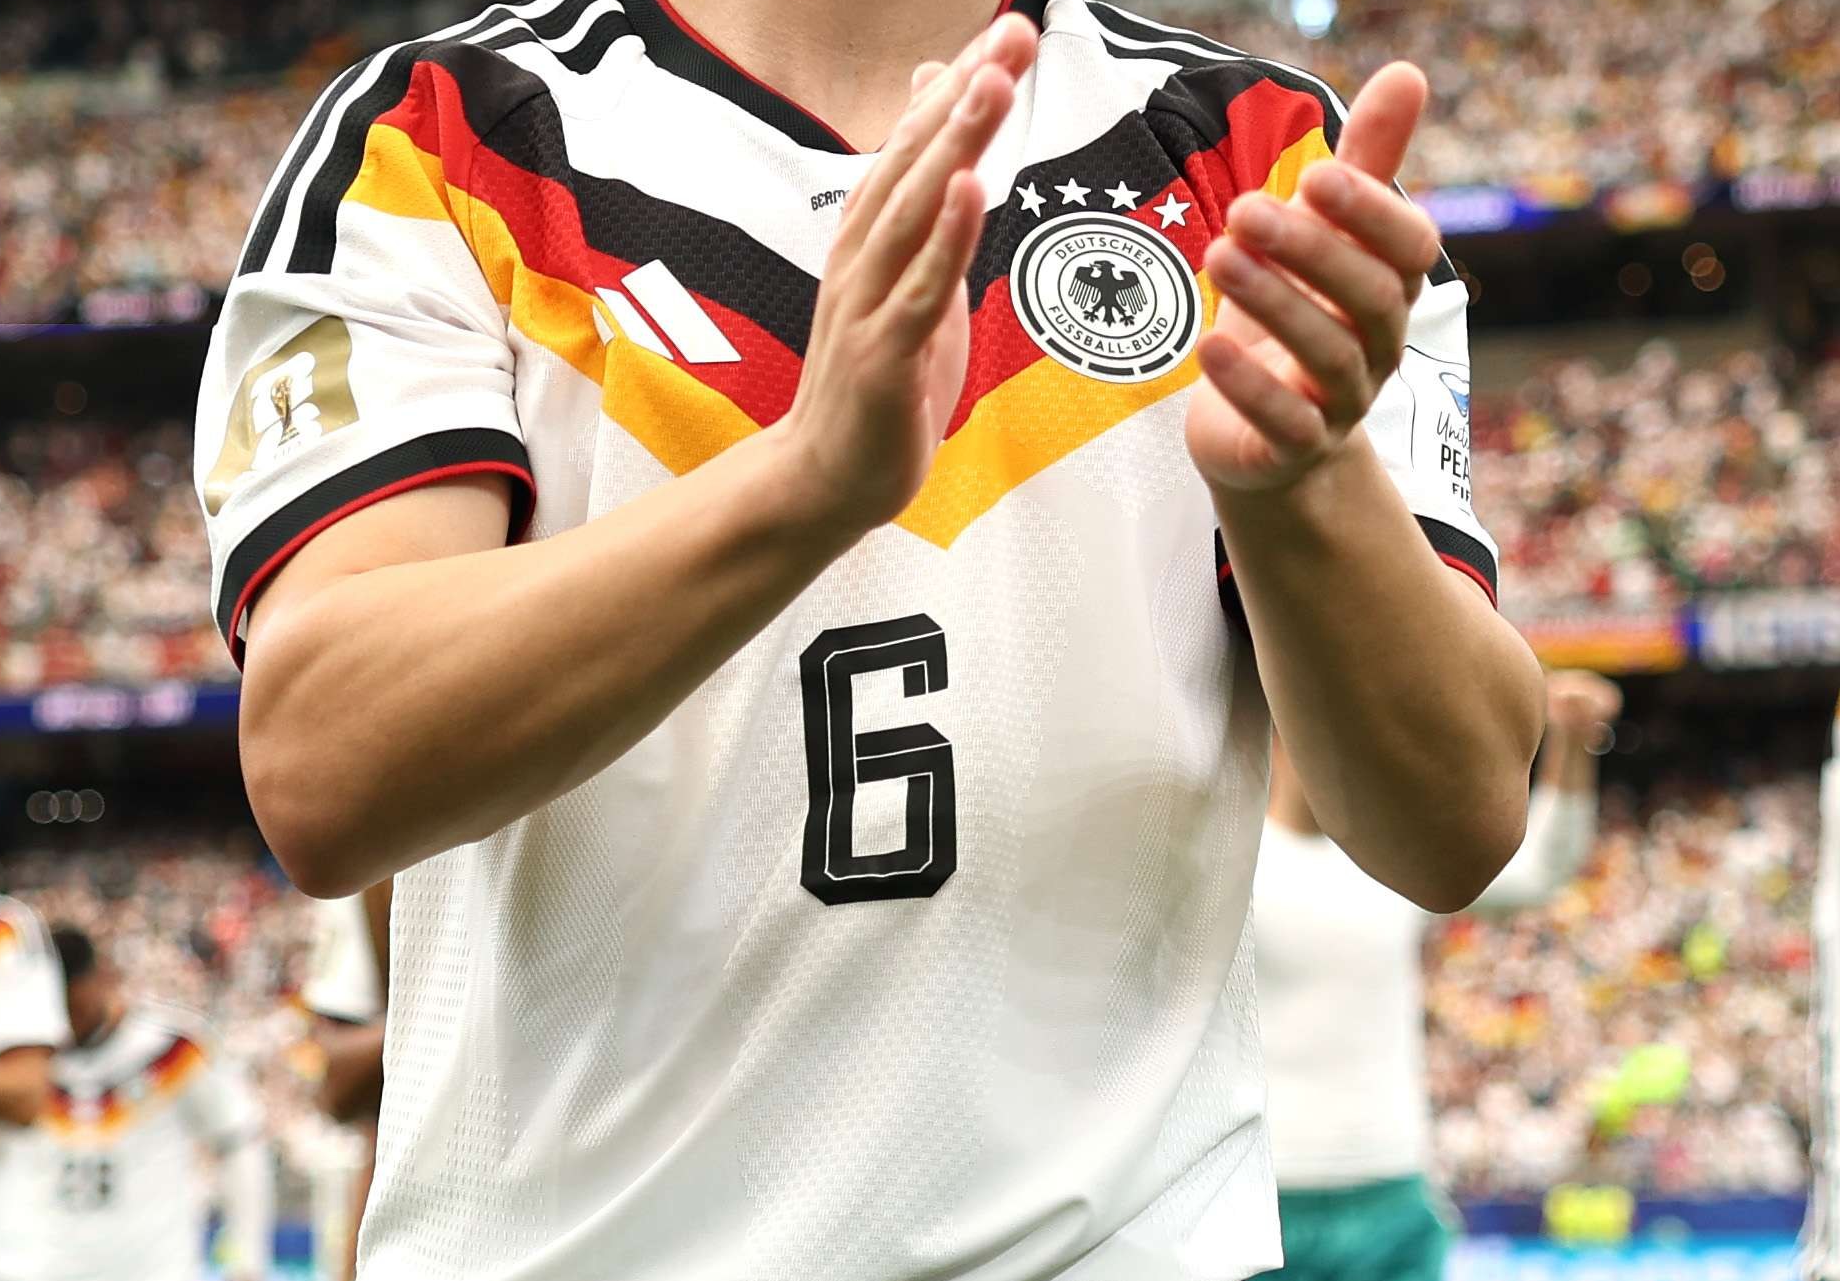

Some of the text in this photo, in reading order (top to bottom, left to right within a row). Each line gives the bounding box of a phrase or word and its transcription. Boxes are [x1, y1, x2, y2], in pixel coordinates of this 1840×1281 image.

[811, 189, 849, 211] GERM
[1054, 236, 1154, 268] DEUTSCHER
[1048, 304, 1169, 354] FUSSBALL-BUND
[1441, 443, 1471, 483] PEA
[1452, 482, 1471, 503] FIF
[799, 613, 958, 906] 6
